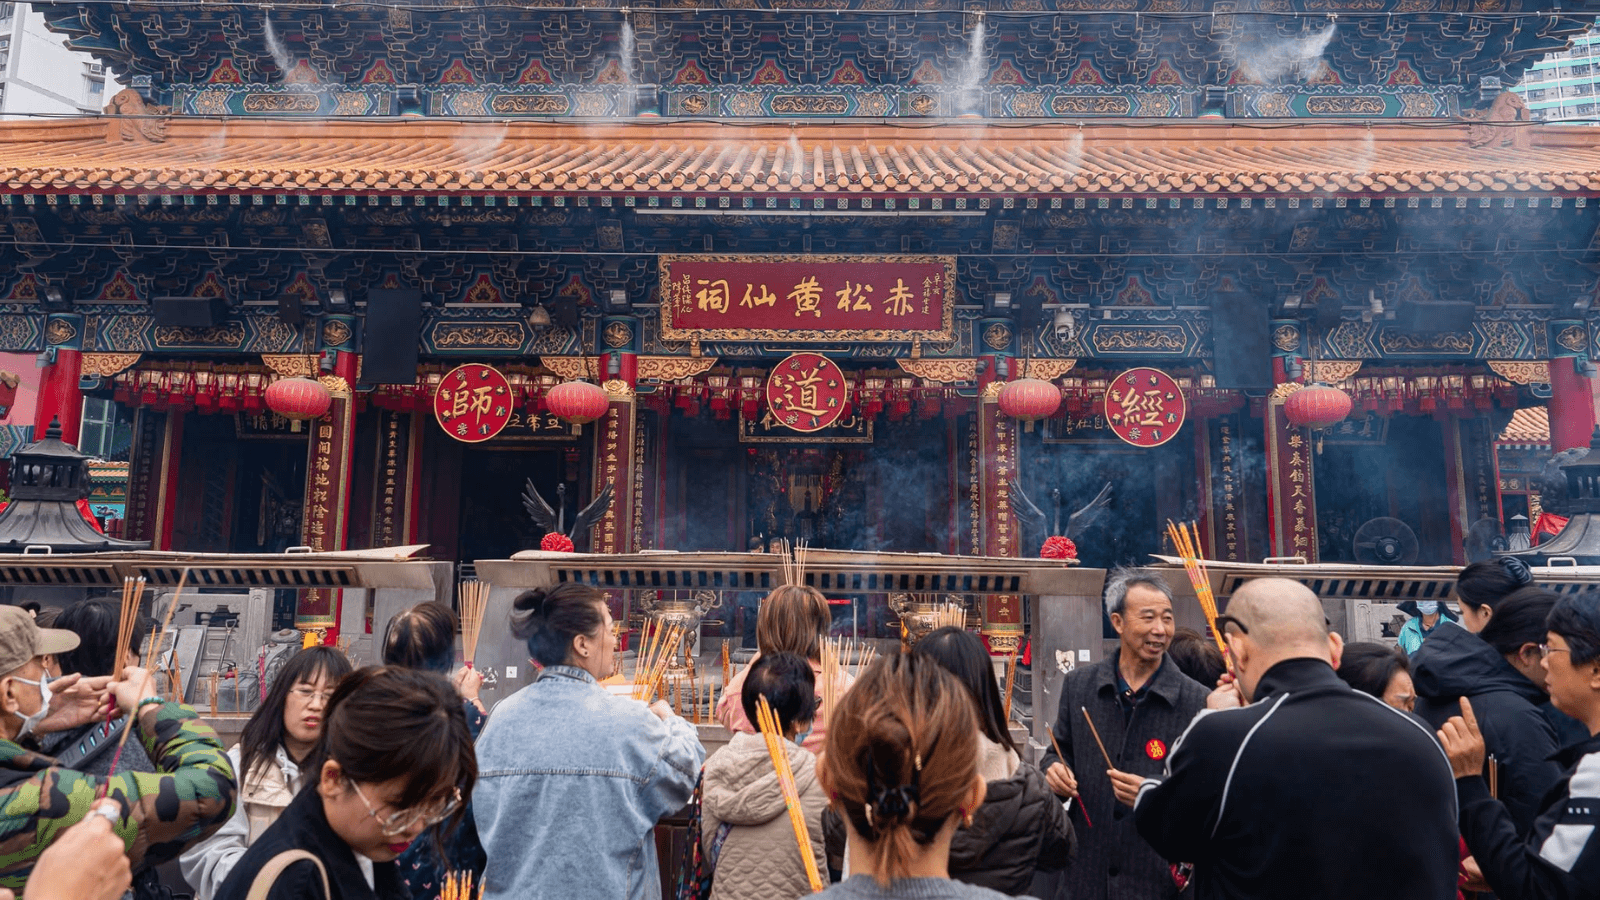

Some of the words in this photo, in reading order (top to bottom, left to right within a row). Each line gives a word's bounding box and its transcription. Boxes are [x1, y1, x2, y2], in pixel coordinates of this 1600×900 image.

[452, 380, 493, 425] 師
[784, 367, 829, 416] 道
[1120, 387, 1165, 428] 經
